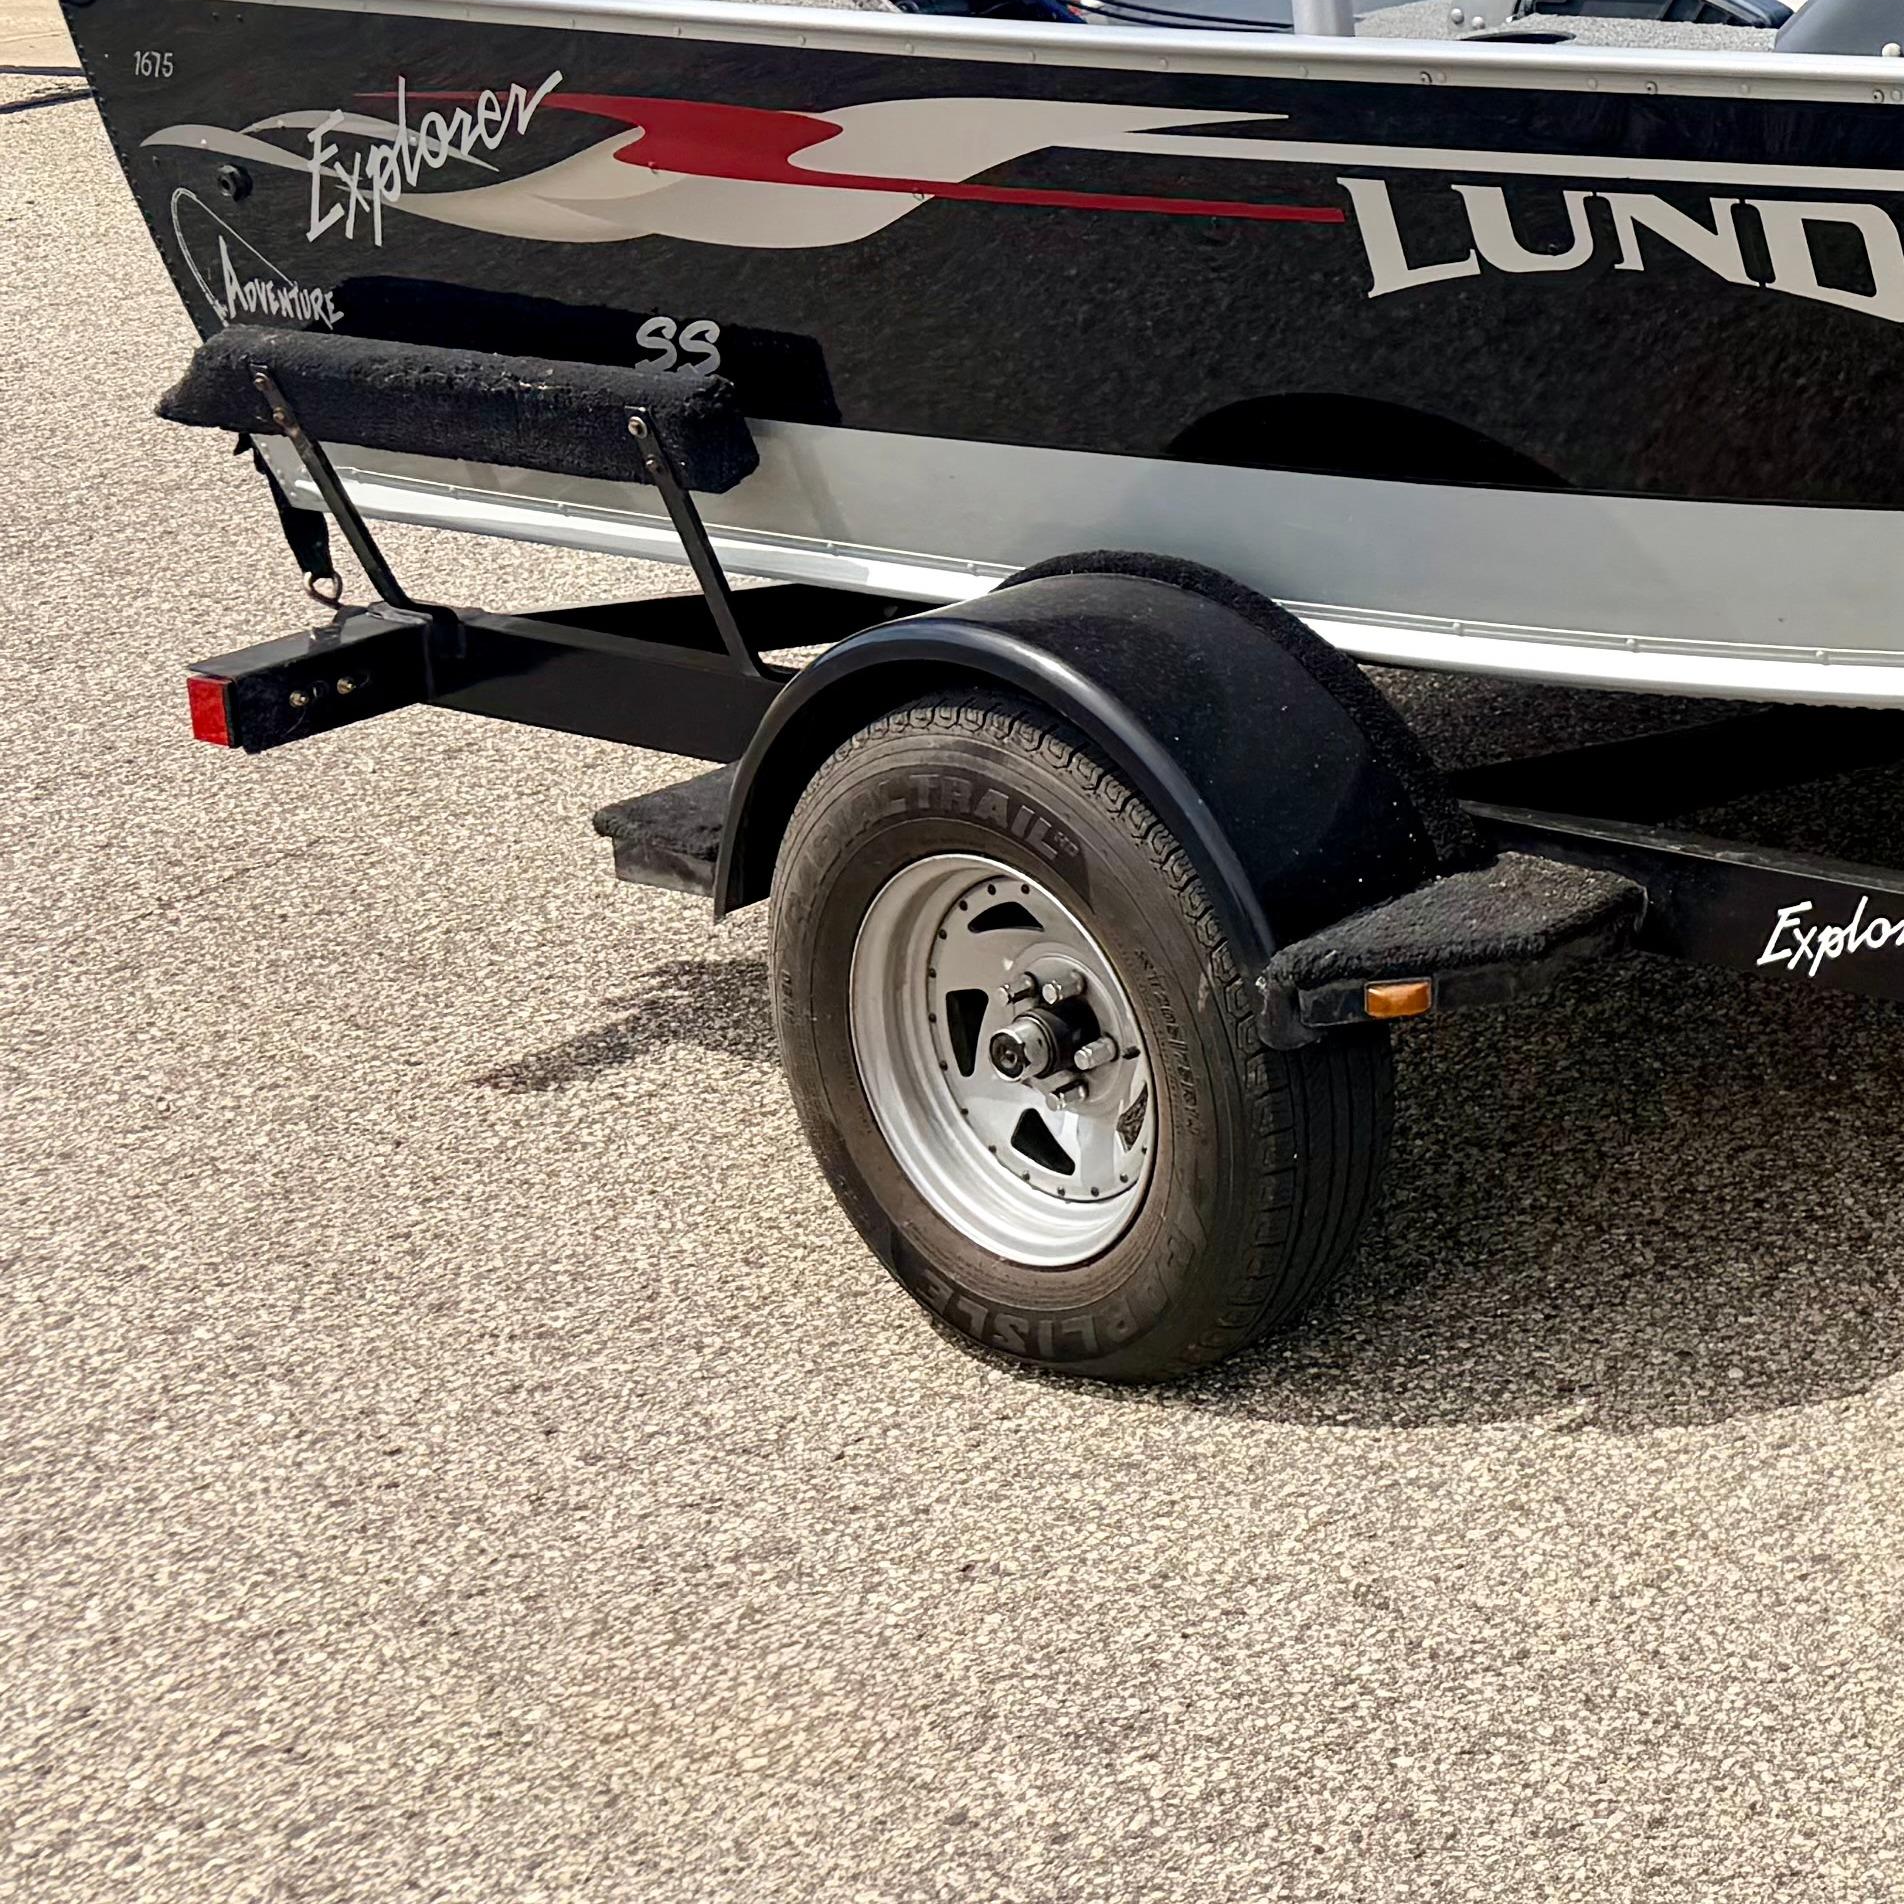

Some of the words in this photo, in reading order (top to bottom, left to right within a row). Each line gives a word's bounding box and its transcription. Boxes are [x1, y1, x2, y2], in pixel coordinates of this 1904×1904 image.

[133, 50, 174, 78] 1675
[306, 69, 564, 248] Explorer
[635, 316, 721, 376] SS
[908, 773, 1059, 860] TRAIL
